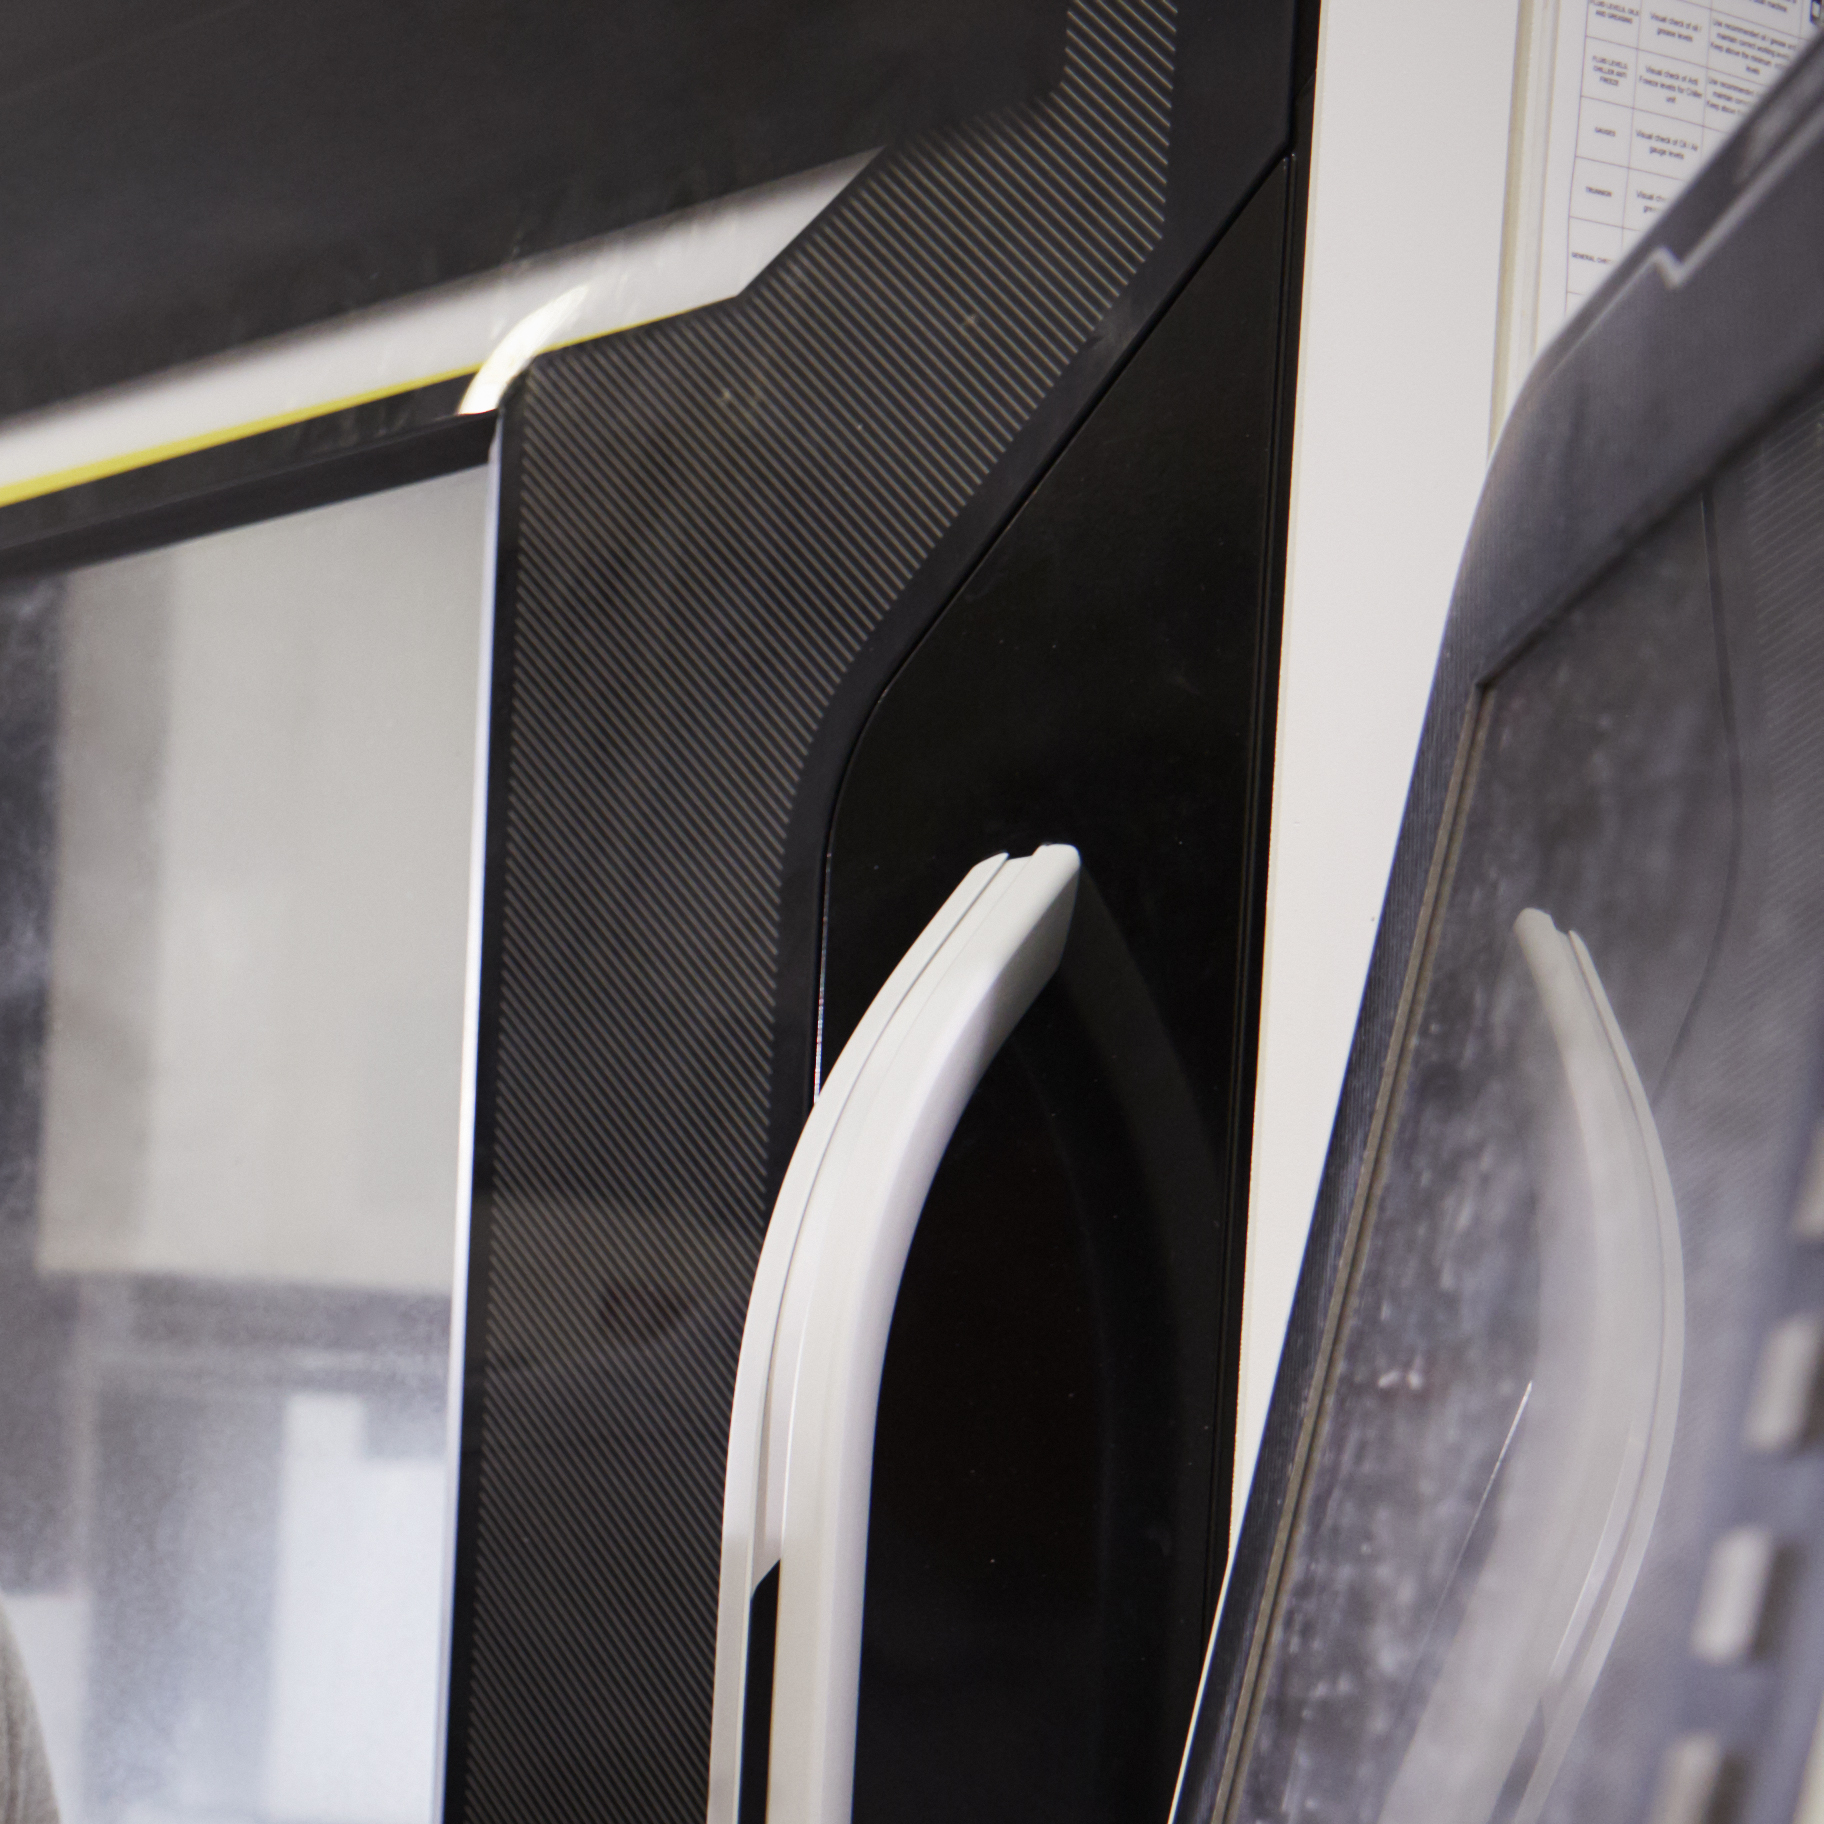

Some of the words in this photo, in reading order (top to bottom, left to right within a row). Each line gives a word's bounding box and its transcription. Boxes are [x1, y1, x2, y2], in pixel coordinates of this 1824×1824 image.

[1650, 12, 1667, 23] Visual
[1669, 18, 1684, 28] check
[1686, 22, 1691, 30] of
[1678, 32, 1693, 42] levels
[1645, 65, 1662, 76] Visual
[1664, 71, 1680, 81] check
[1681, 75, 1687, 83] of
[1659, 82, 1676, 92] levels
[1635, 129, 1653, 140] Visual
[1654, 135, 1671, 145] check
[1672, 138, 1678, 146] of
[1668, 150, 1684, 160] levels
[1636, 190, 1654, 201] Visual
[1571, 251, 1596, 263] GENERAL
